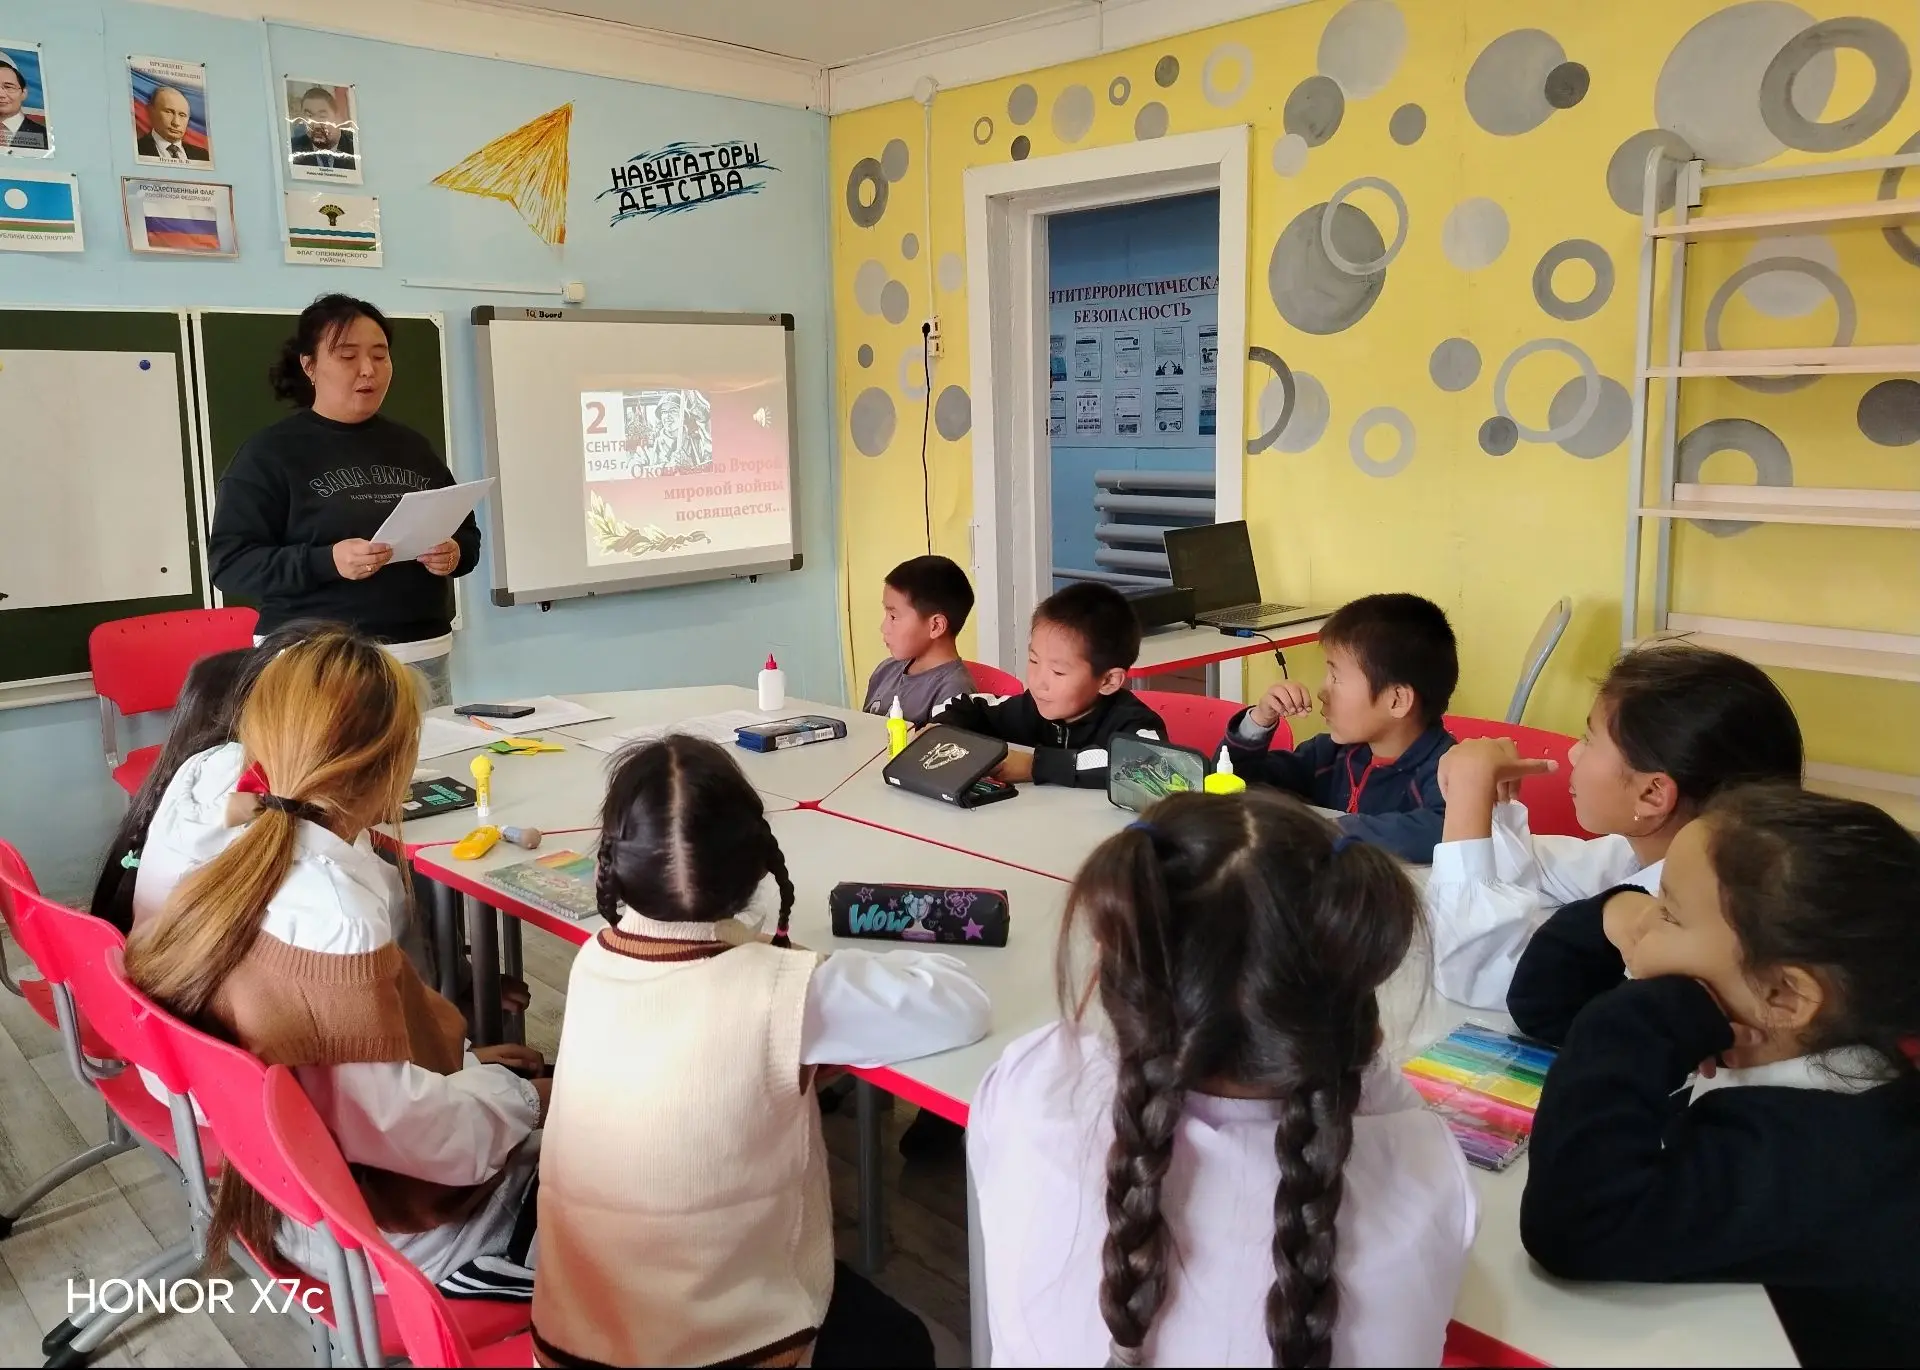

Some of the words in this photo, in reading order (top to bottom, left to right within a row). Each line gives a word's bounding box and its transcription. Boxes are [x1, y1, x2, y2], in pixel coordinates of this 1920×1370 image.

[611, 143, 760, 188] НАВИГАТОРЫ
[139, 184, 199, 195] ГОСУДАРСТВЕННЫЙ
[619, 170, 744, 214] ДЕТСТВА
[1073, 302, 1192, 324] БЕЗОПАСНОСТЬ
[585, 401, 608, 435] 2
[587, 459, 617, 471] 1945
[663, 480, 733, 504] мировой
